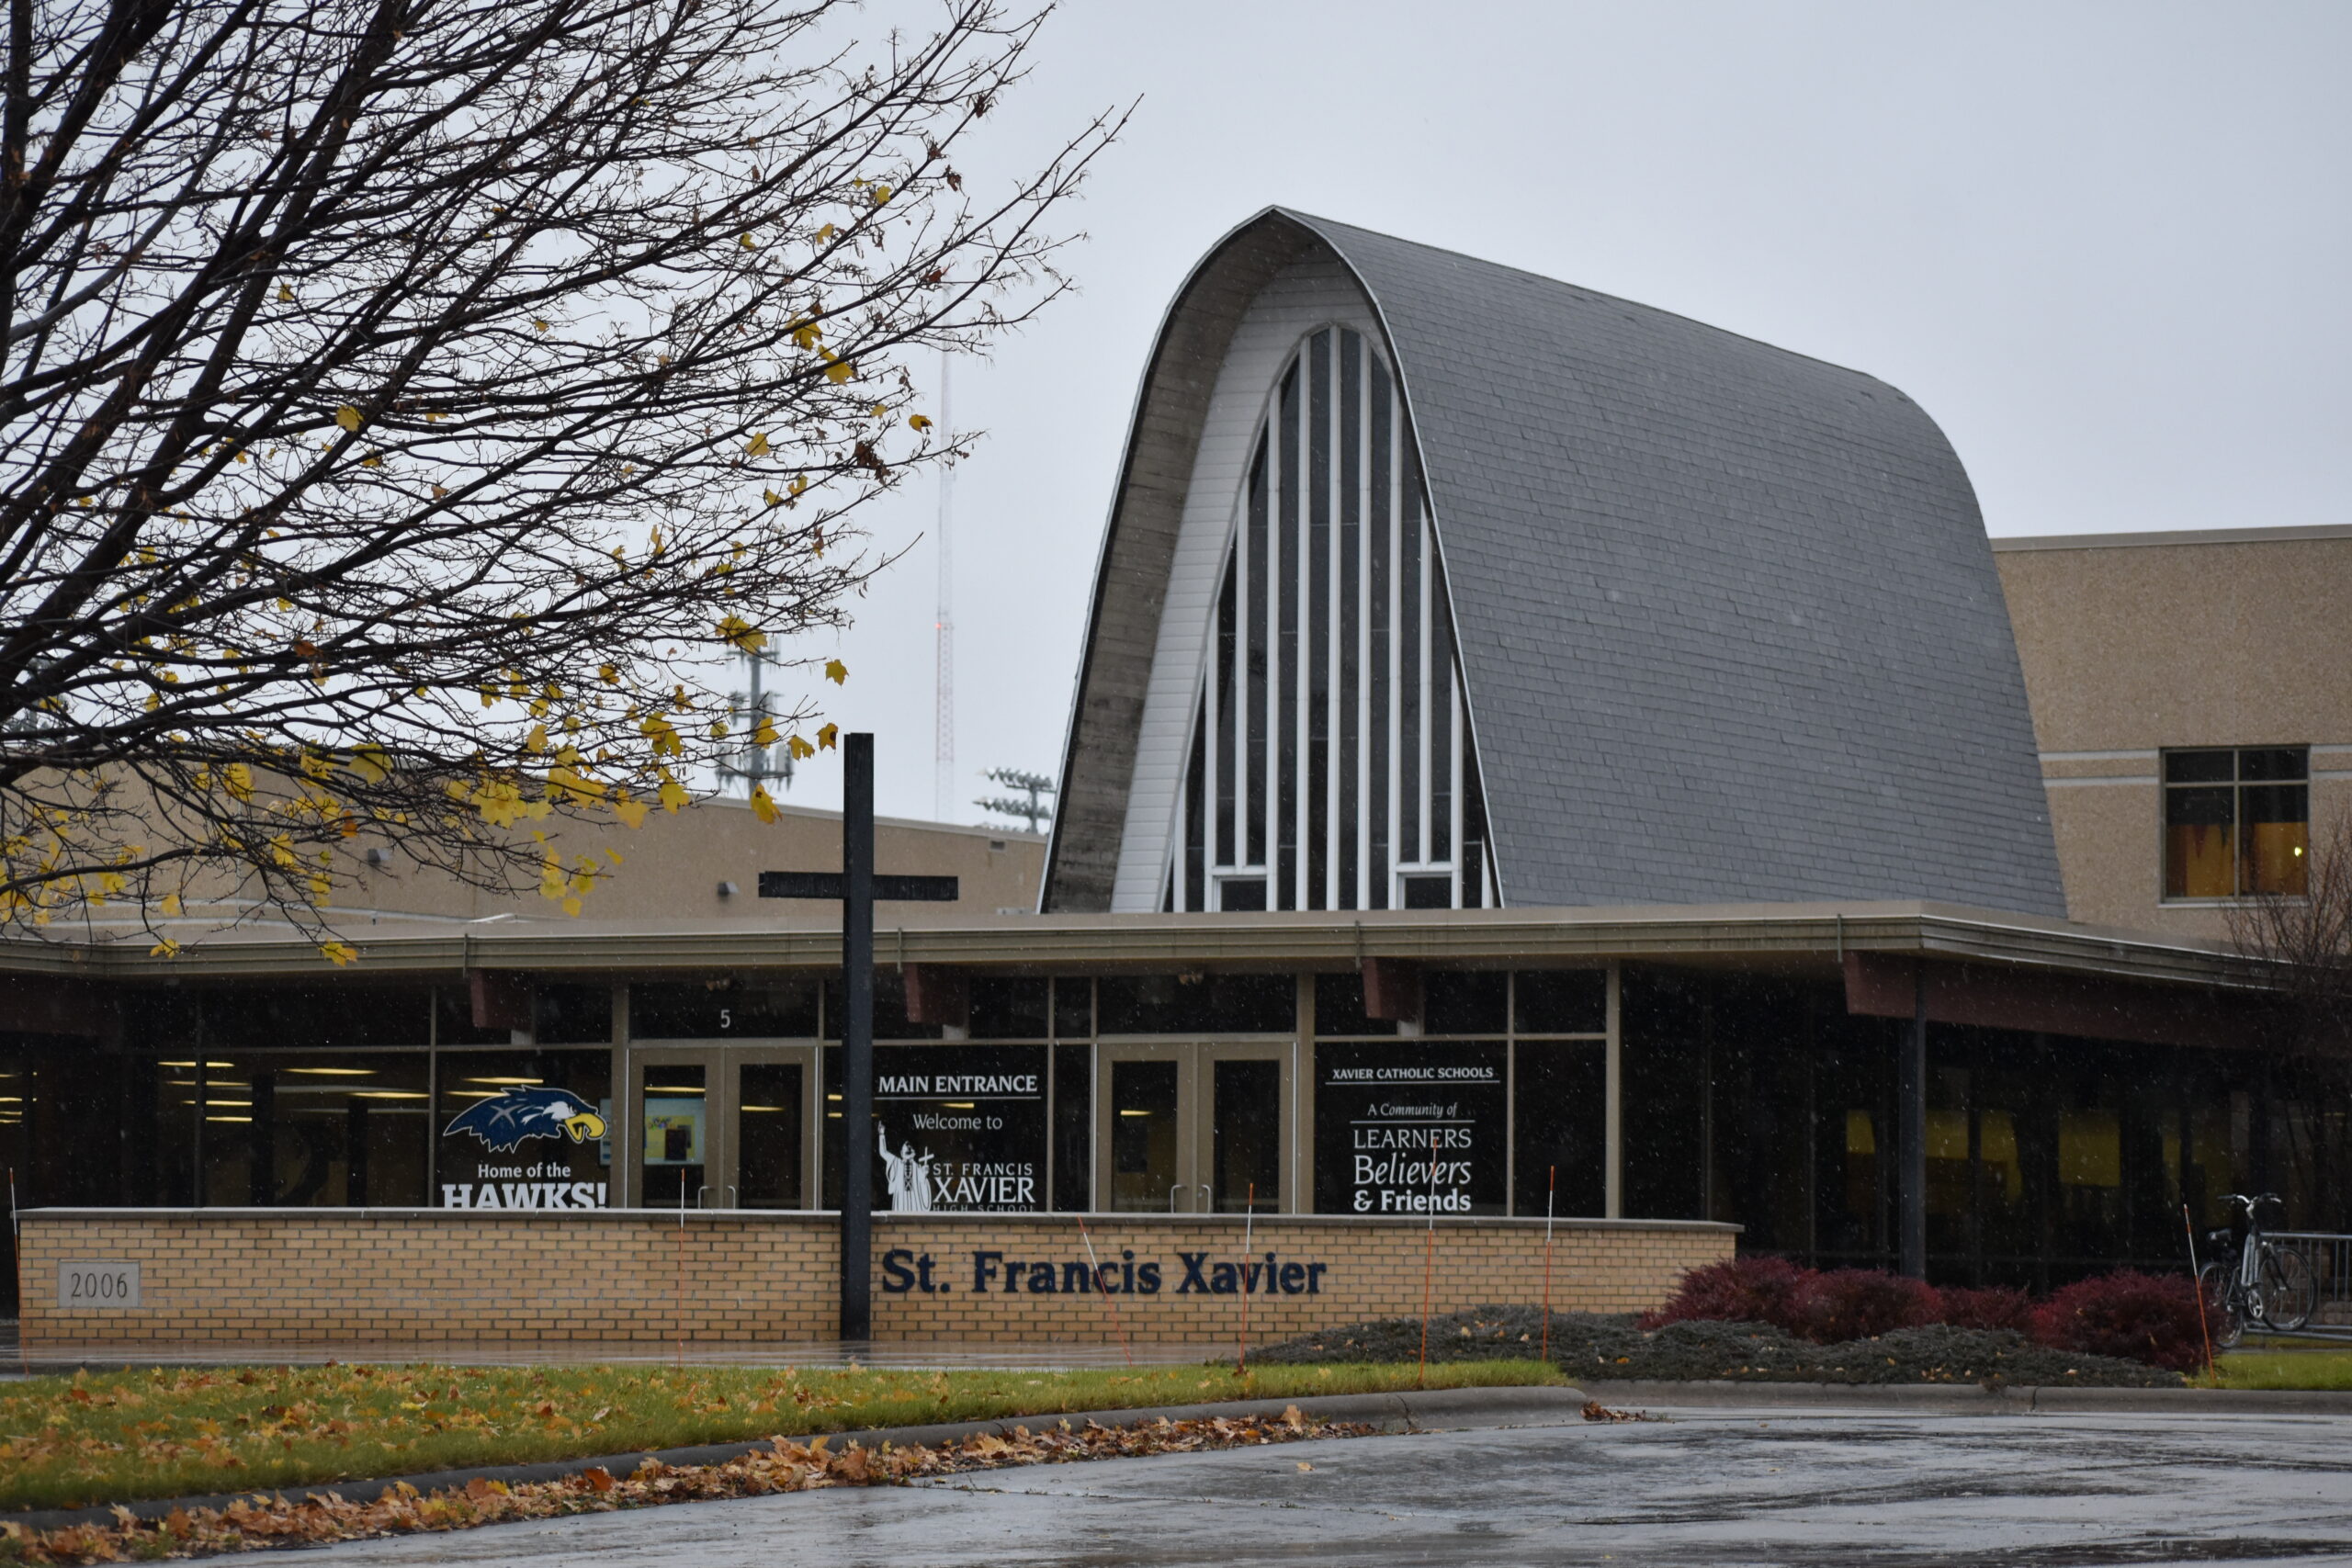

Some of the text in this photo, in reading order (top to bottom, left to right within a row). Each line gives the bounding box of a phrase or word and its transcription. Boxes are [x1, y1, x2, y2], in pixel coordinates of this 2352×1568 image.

[720, 1010, 731, 1029] 5
[1332, 1066, 1494, 1079] XAVIER CATHOLIC SCHOOLS
[878, 1075, 1038, 1093] MAIN ENTRANCE
[1367, 1102, 1458, 1118] A Community of
[913, 1112, 1003, 1130] Welcome to
[1354, 1128, 1472, 1148] LEARNERS
[478, 1162, 571, 1179] Home of the
[933, 1163, 1033, 1176] ST. FRANCIS
[1354, 1152, 1472, 1185] Believers
[442, 1182, 607, 1209] HAWKS!
[933, 1177, 1036, 1203] XAVIER
[1353, 1188, 1472, 1212] & Friends
[882, 1249, 1328, 1293] St. Francis Xavier
[71, 1272, 128, 1298] 2006
